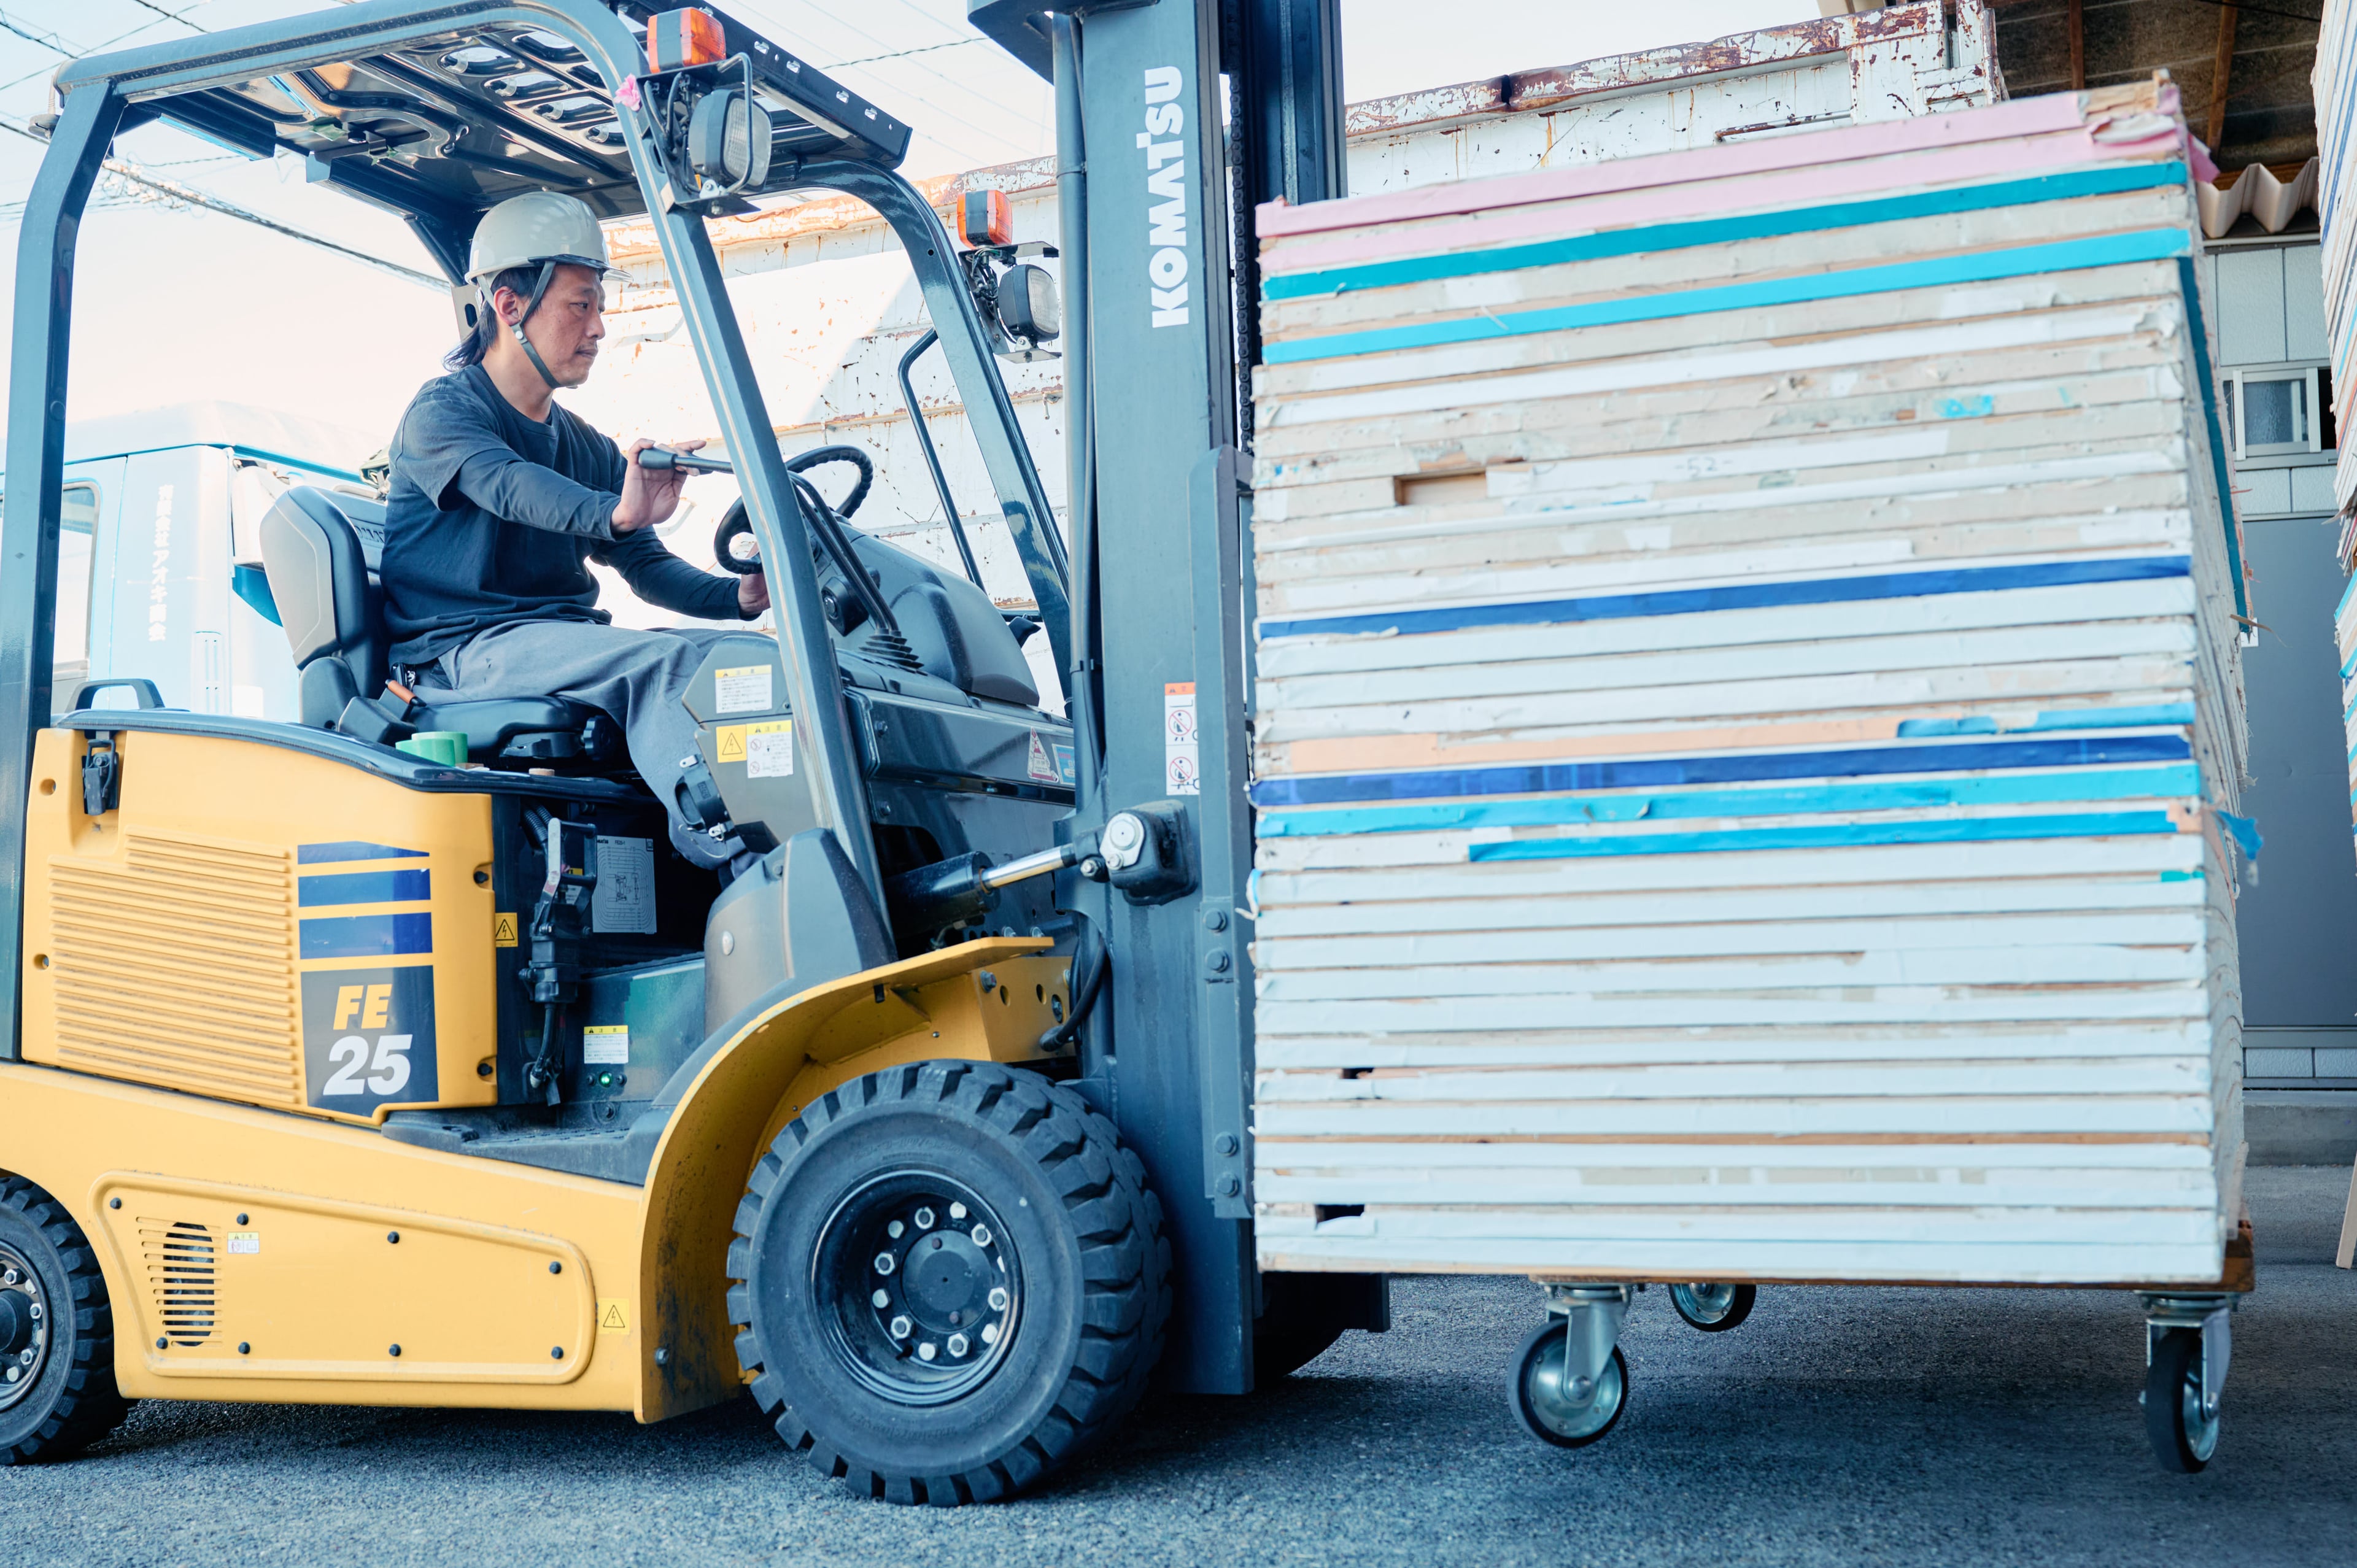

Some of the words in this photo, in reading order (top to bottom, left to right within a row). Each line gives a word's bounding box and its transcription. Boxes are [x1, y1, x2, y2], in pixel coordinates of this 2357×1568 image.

[1136, 66, 1189, 328] KOMATSU
[333, 984, 392, 1030] FE
[323, 1034, 412, 1095] 25
